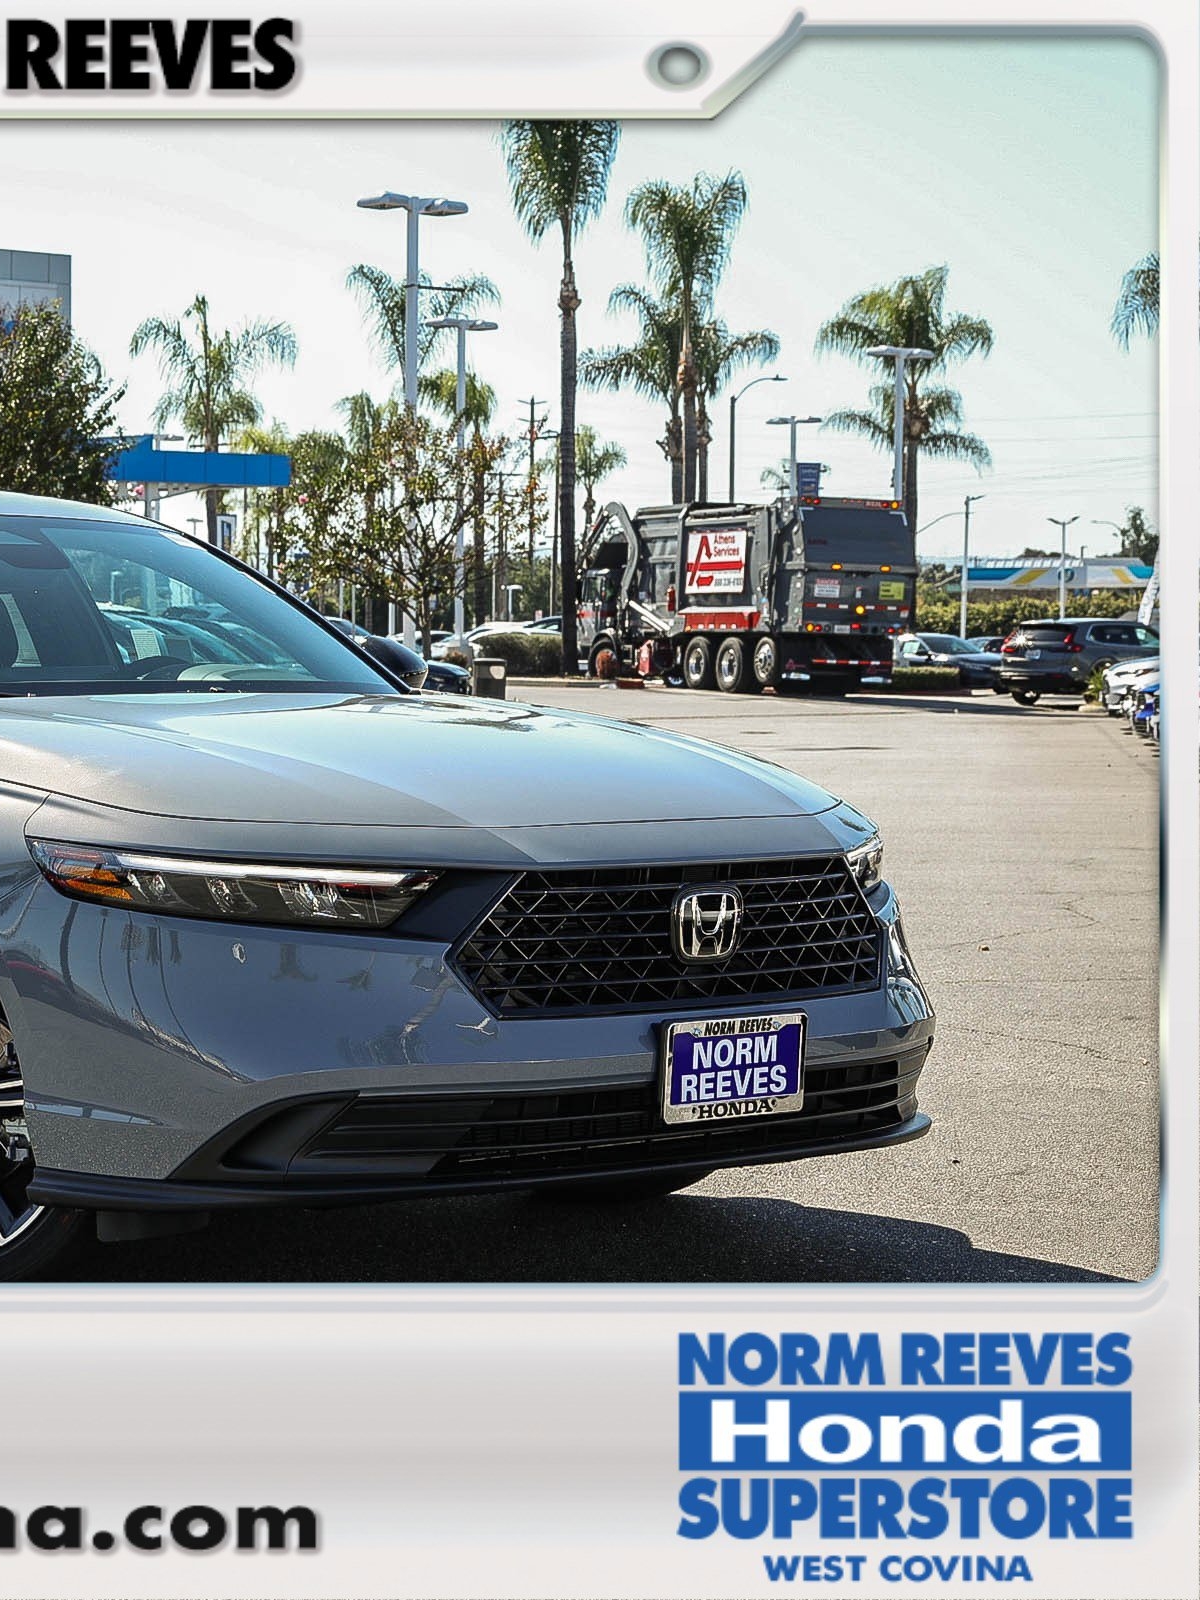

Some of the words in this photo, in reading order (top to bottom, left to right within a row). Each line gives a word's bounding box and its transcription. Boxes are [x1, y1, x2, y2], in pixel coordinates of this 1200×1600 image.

[704, 1021, 736, 1036] NORM
[739, 1018, 773, 1033] REEVES
[692, 1035, 778, 1070] NORM
[681, 1065, 787, 1102] REEVES
[698, 1099, 774, 1119] HONDA
